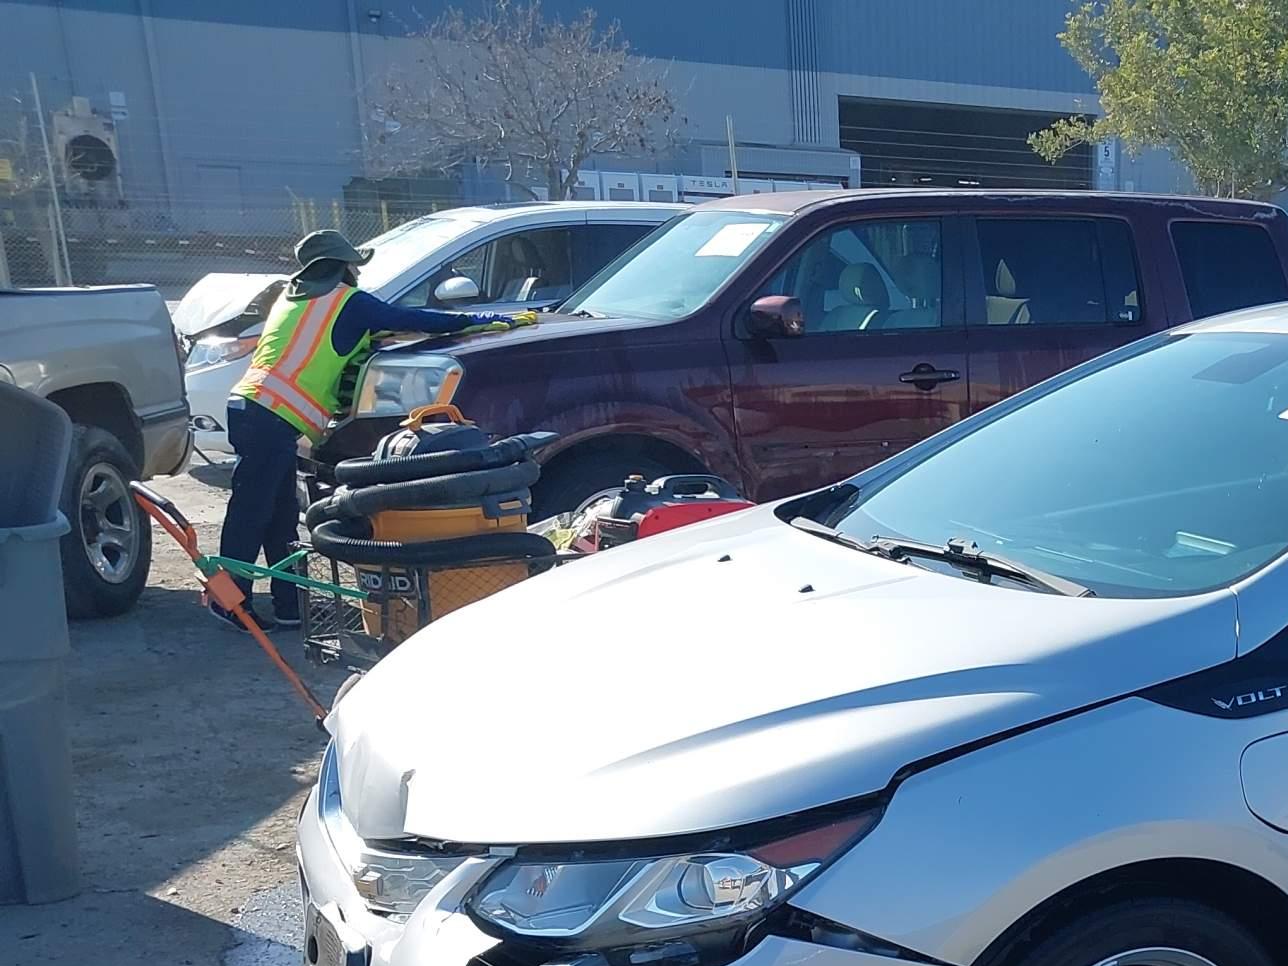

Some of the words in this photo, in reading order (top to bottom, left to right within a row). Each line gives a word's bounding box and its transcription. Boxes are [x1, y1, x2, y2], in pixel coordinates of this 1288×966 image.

[690, 179, 728, 188] TESLA
[360, 573, 411, 591] RIDID
[1210, 685, 1287, 711] VOLT
